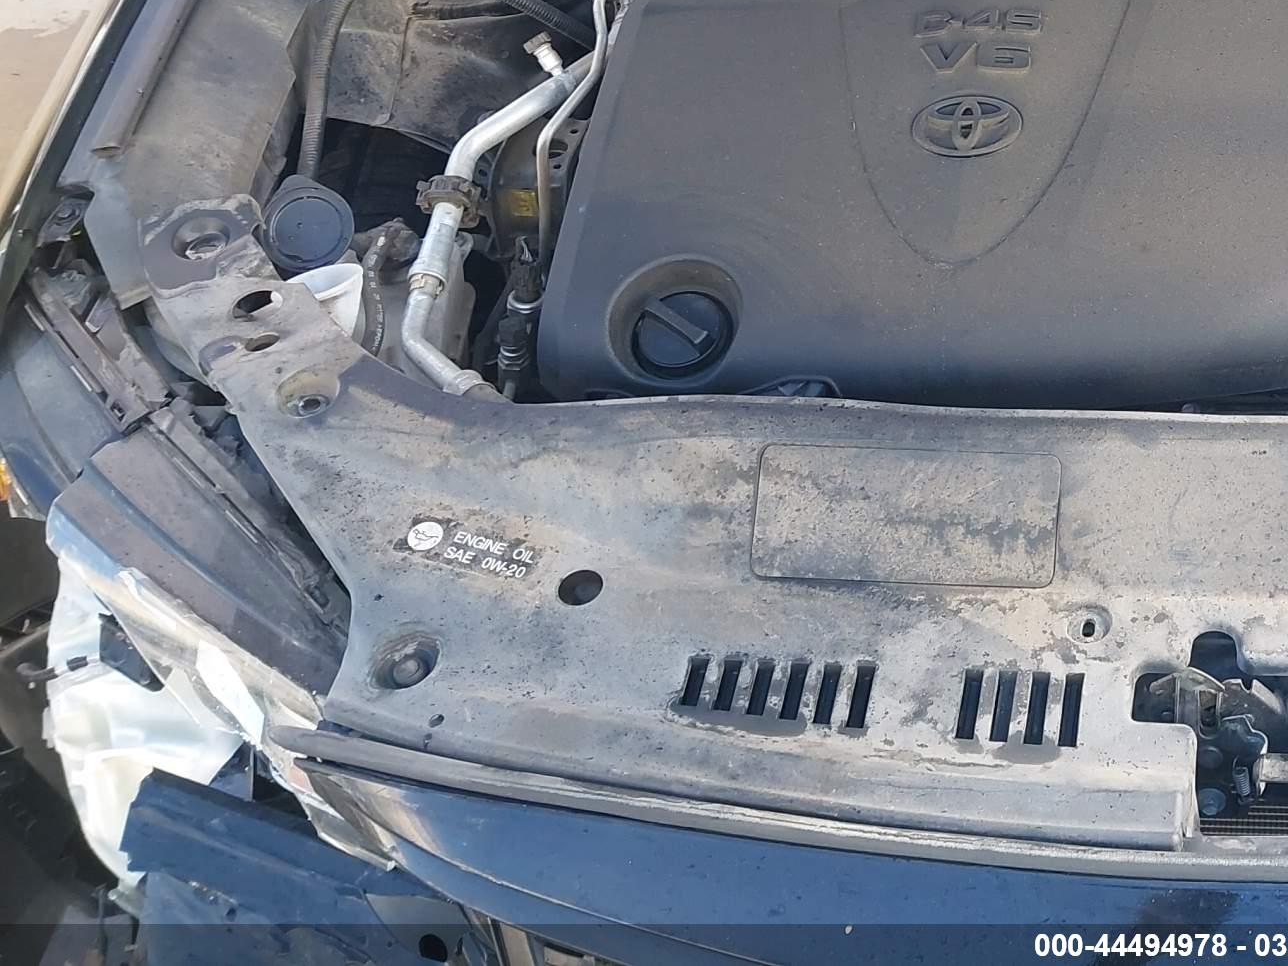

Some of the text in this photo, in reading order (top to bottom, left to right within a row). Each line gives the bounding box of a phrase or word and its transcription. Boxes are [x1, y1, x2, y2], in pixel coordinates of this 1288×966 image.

[919, 40, 1031, 74] V6
[443, 546, 527, 578] SAE 0W-20
[454, 531, 534, 564] ENGINE OIL
